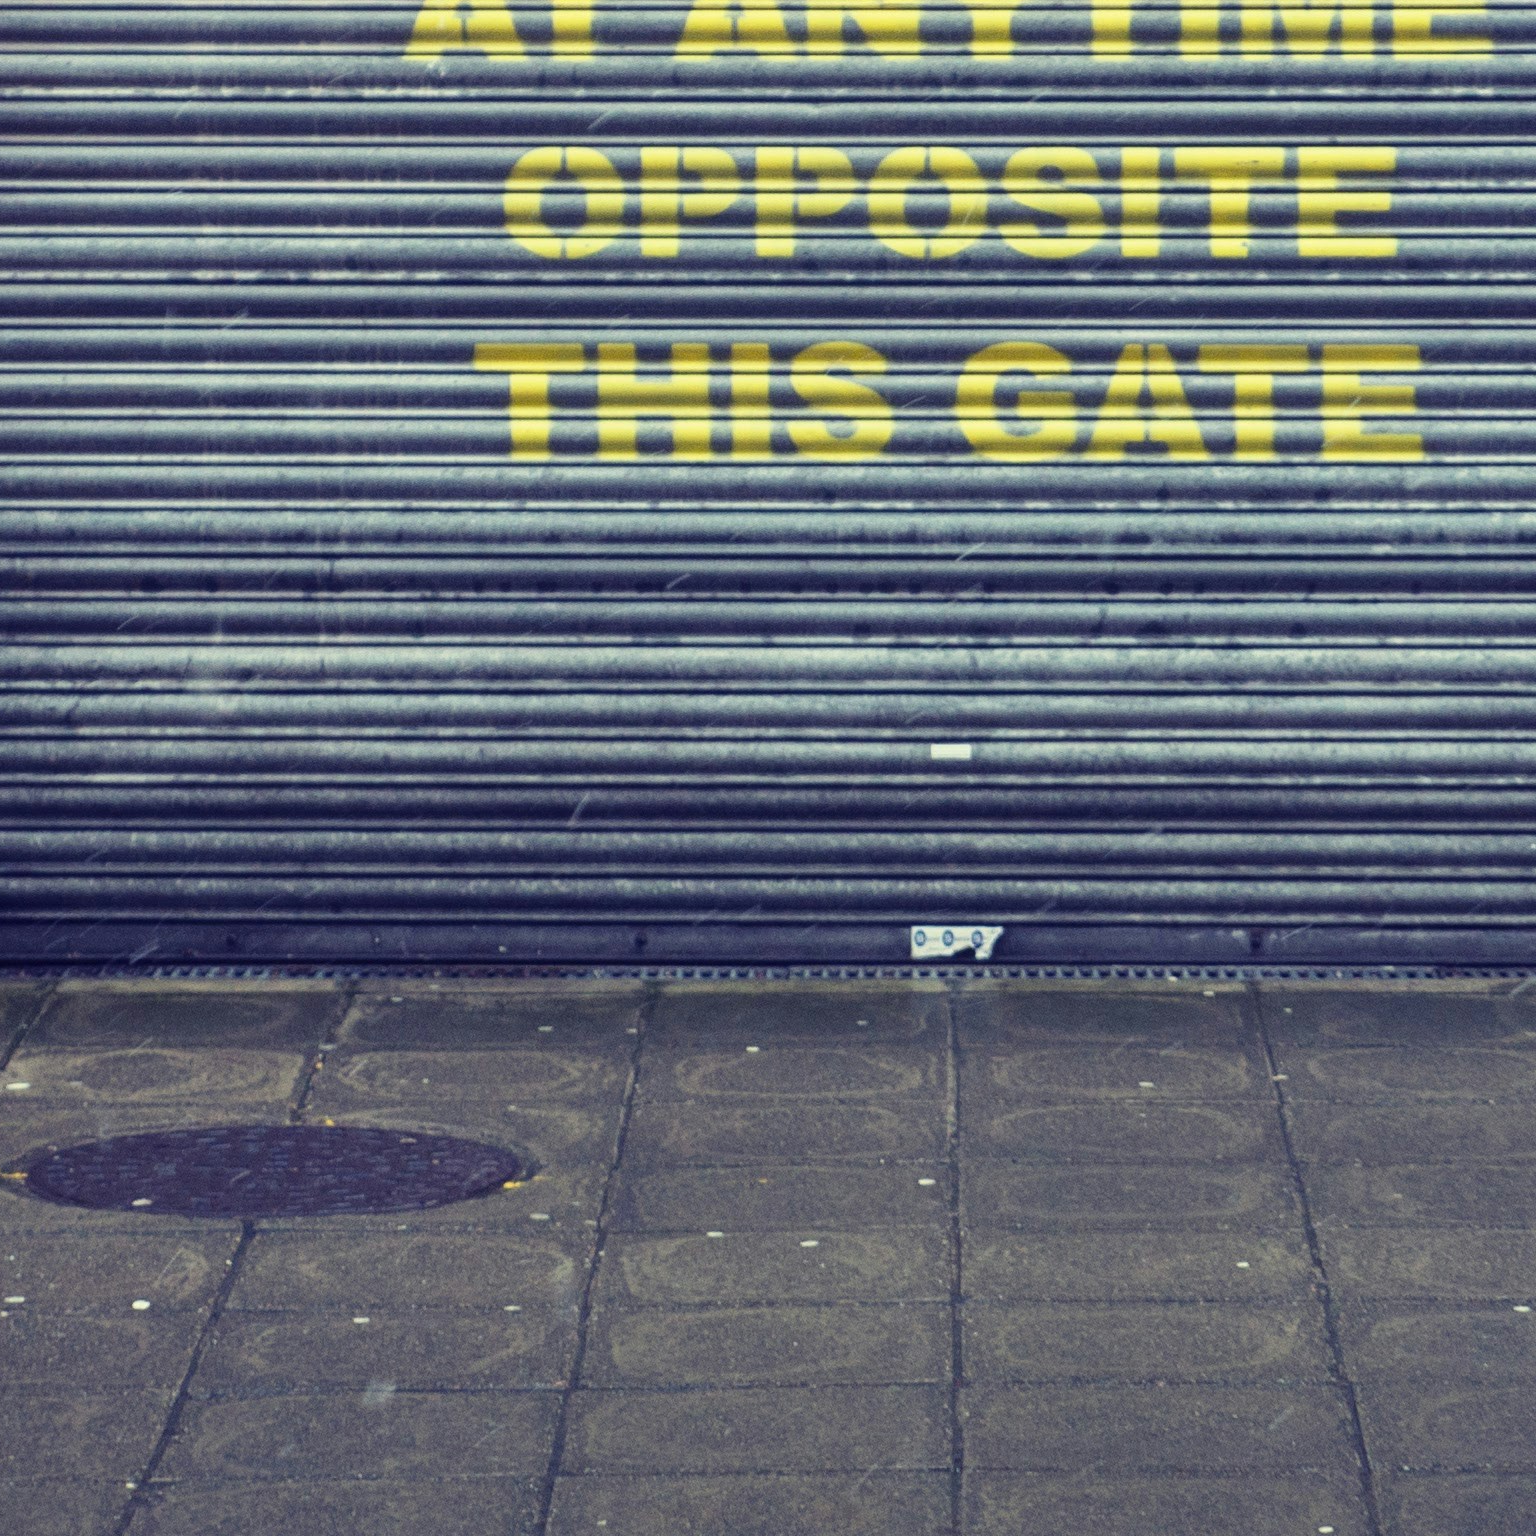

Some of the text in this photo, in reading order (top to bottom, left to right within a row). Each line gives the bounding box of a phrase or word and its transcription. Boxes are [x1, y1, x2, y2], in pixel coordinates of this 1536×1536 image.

[502, 146, 1398, 259] OPPOSITE
[472, 341, 1426, 463] THIS GATE
